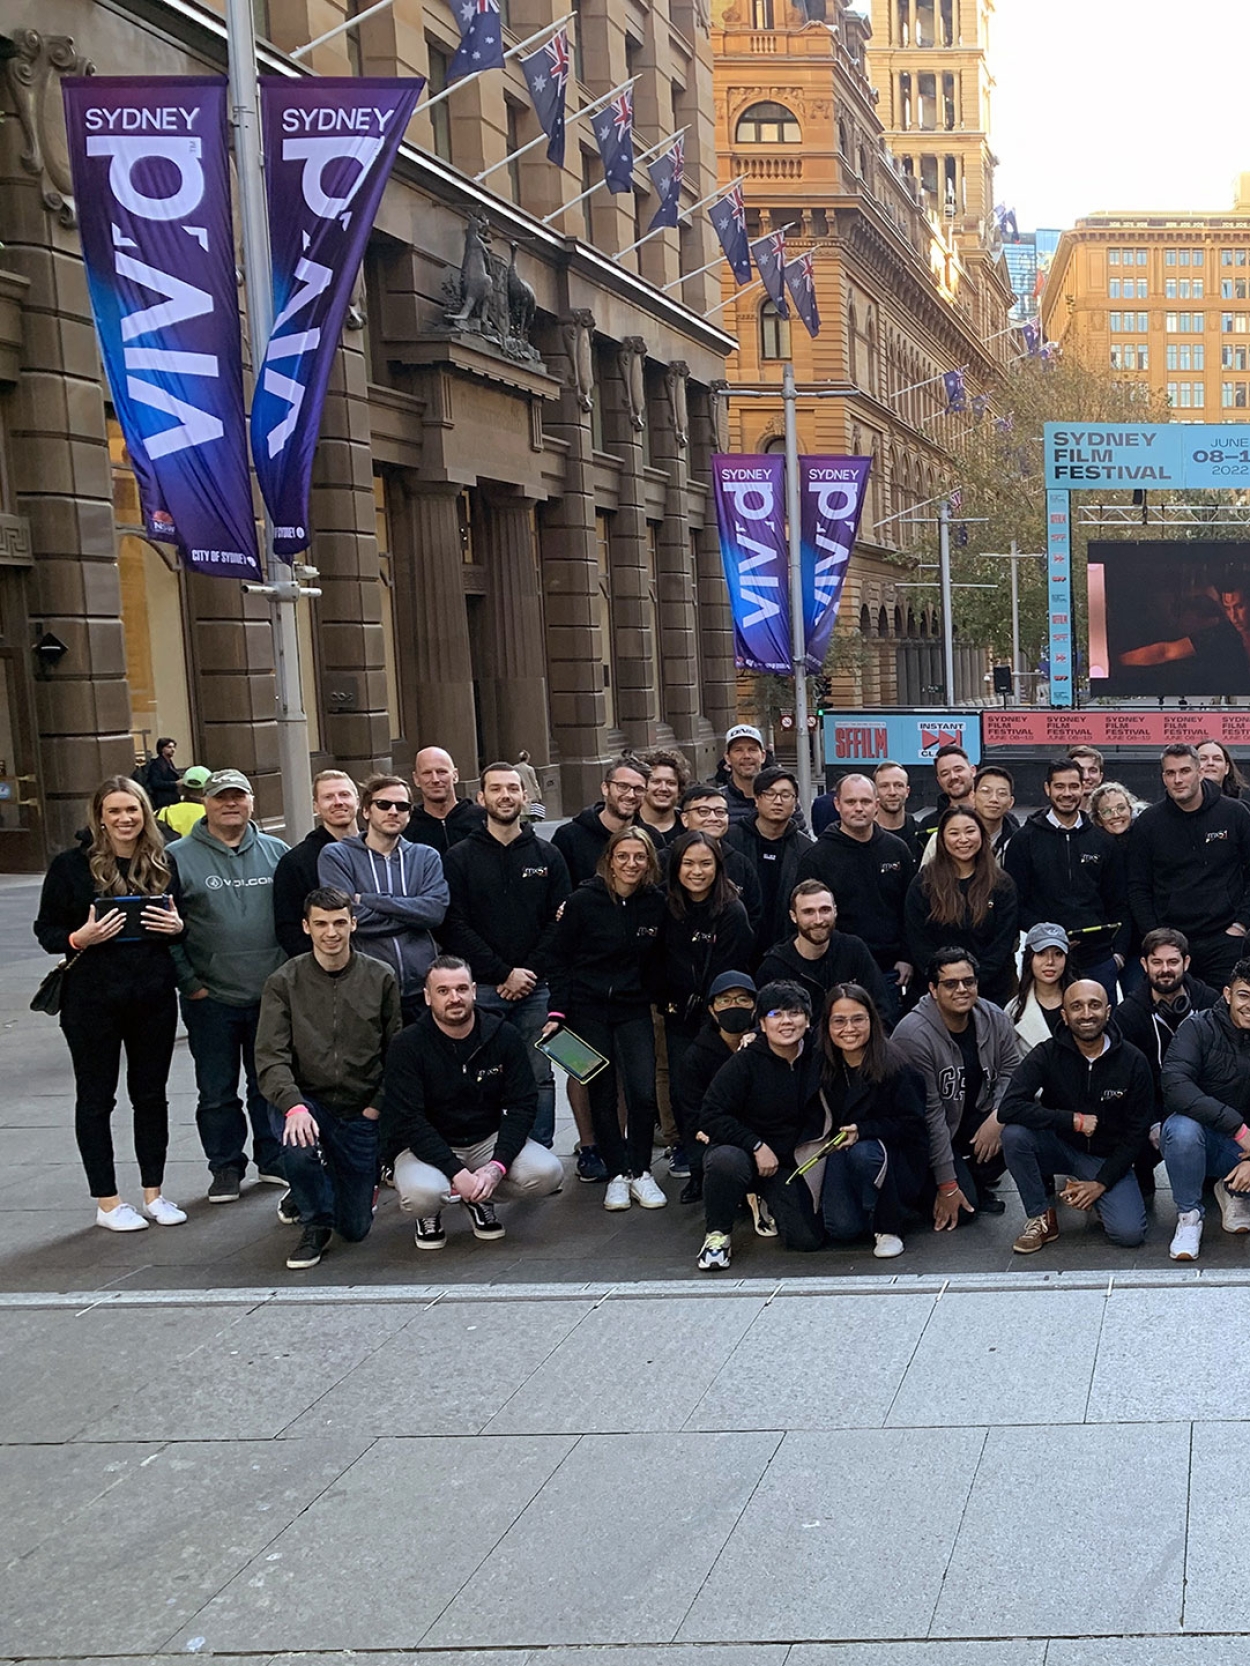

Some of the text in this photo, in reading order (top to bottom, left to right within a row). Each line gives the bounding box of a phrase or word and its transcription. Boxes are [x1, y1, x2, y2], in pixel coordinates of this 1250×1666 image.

[84, 106, 200, 130] SYDNEY
[282, 107, 395, 132] SYDNEY
[1053, 432, 1157, 447] SYDNEY
[1210, 438, 1249, 448] JUNE
[1054, 449, 1113, 463] FILM
[721, 468, 773, 481] SYDNEY
[808, 468, 860, 481] SYDNEY
[1054, 465, 1172, 480] FESTIVAL
[1211, 465, 1250, 475] 2022
[919, 722, 965, 731] INSTANT
[835, 727, 888, 759] SFFILM
